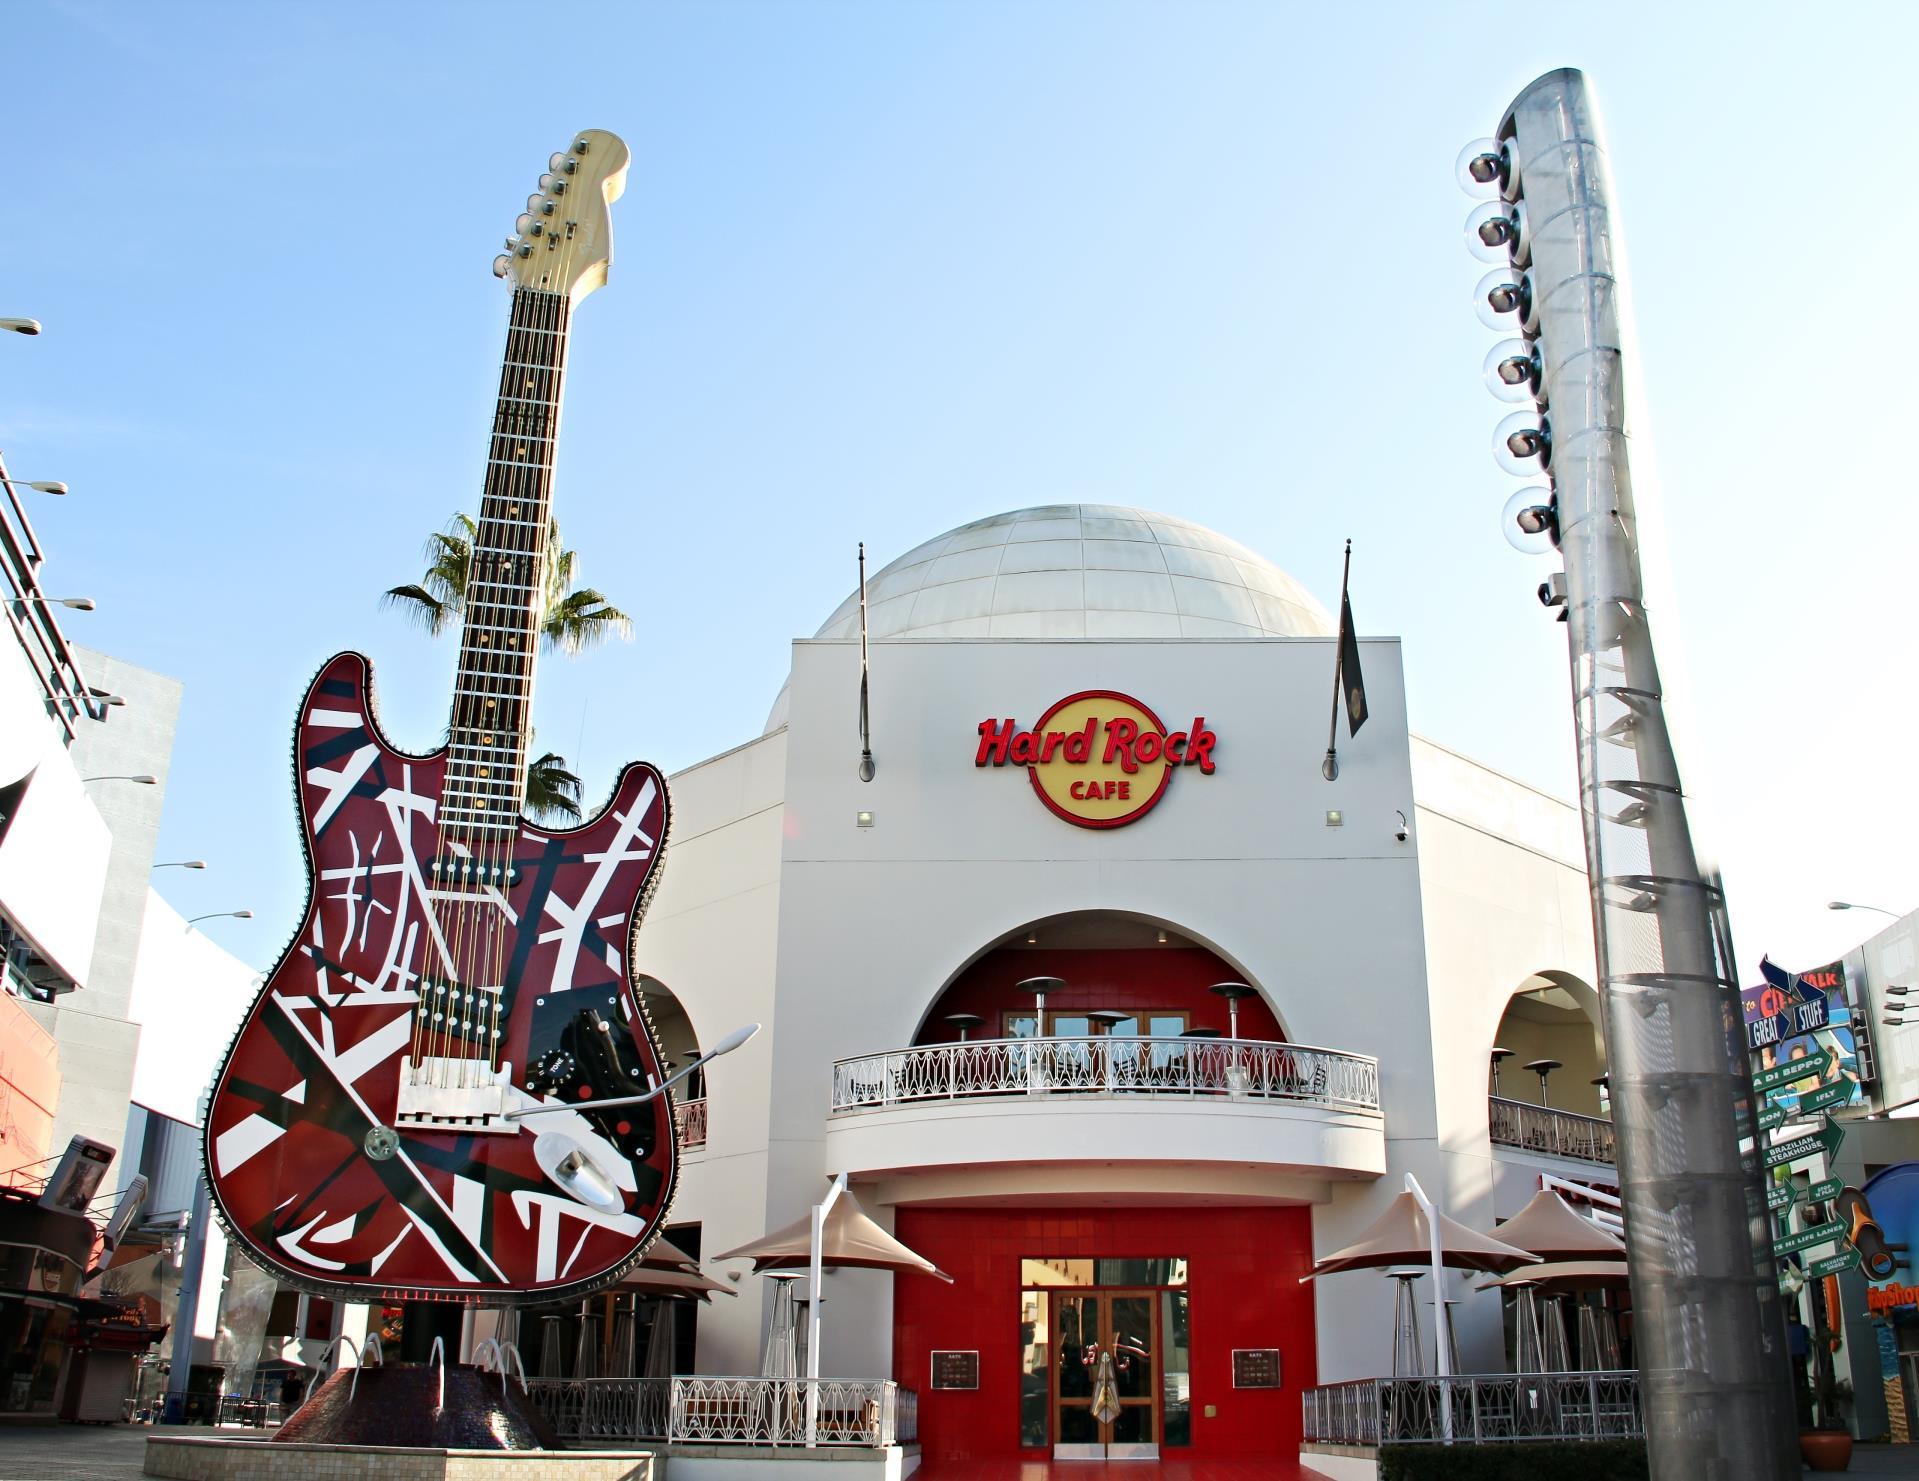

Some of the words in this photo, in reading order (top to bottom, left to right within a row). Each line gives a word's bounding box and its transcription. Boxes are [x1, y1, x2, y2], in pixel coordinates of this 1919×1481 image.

[975, 718, 1098, 767] Hard
[1102, 718, 1217, 775] Rock
[1070, 781, 1130, 800] CAFE
[1753, 1016, 1778, 1046] GREAT
[1799, 1000, 1823, 1030] STUFF
[550, 1057, 564, 1072] TONE
[1765, 1073, 1779, 1082] DI
[1782, 1057, 1823, 1077] BEPPO
[1816, 1089, 1836, 1102] IFLY
[1767, 1140, 1823, 1164] STEAKHOUSE
[1769, 1135, 1814, 1156] BRAZILIAN
[1785, 1240, 1795, 1248] HI
[1798, 1233, 1814, 1244] LIFE
[1816, 1224, 1844, 1237] LANES
